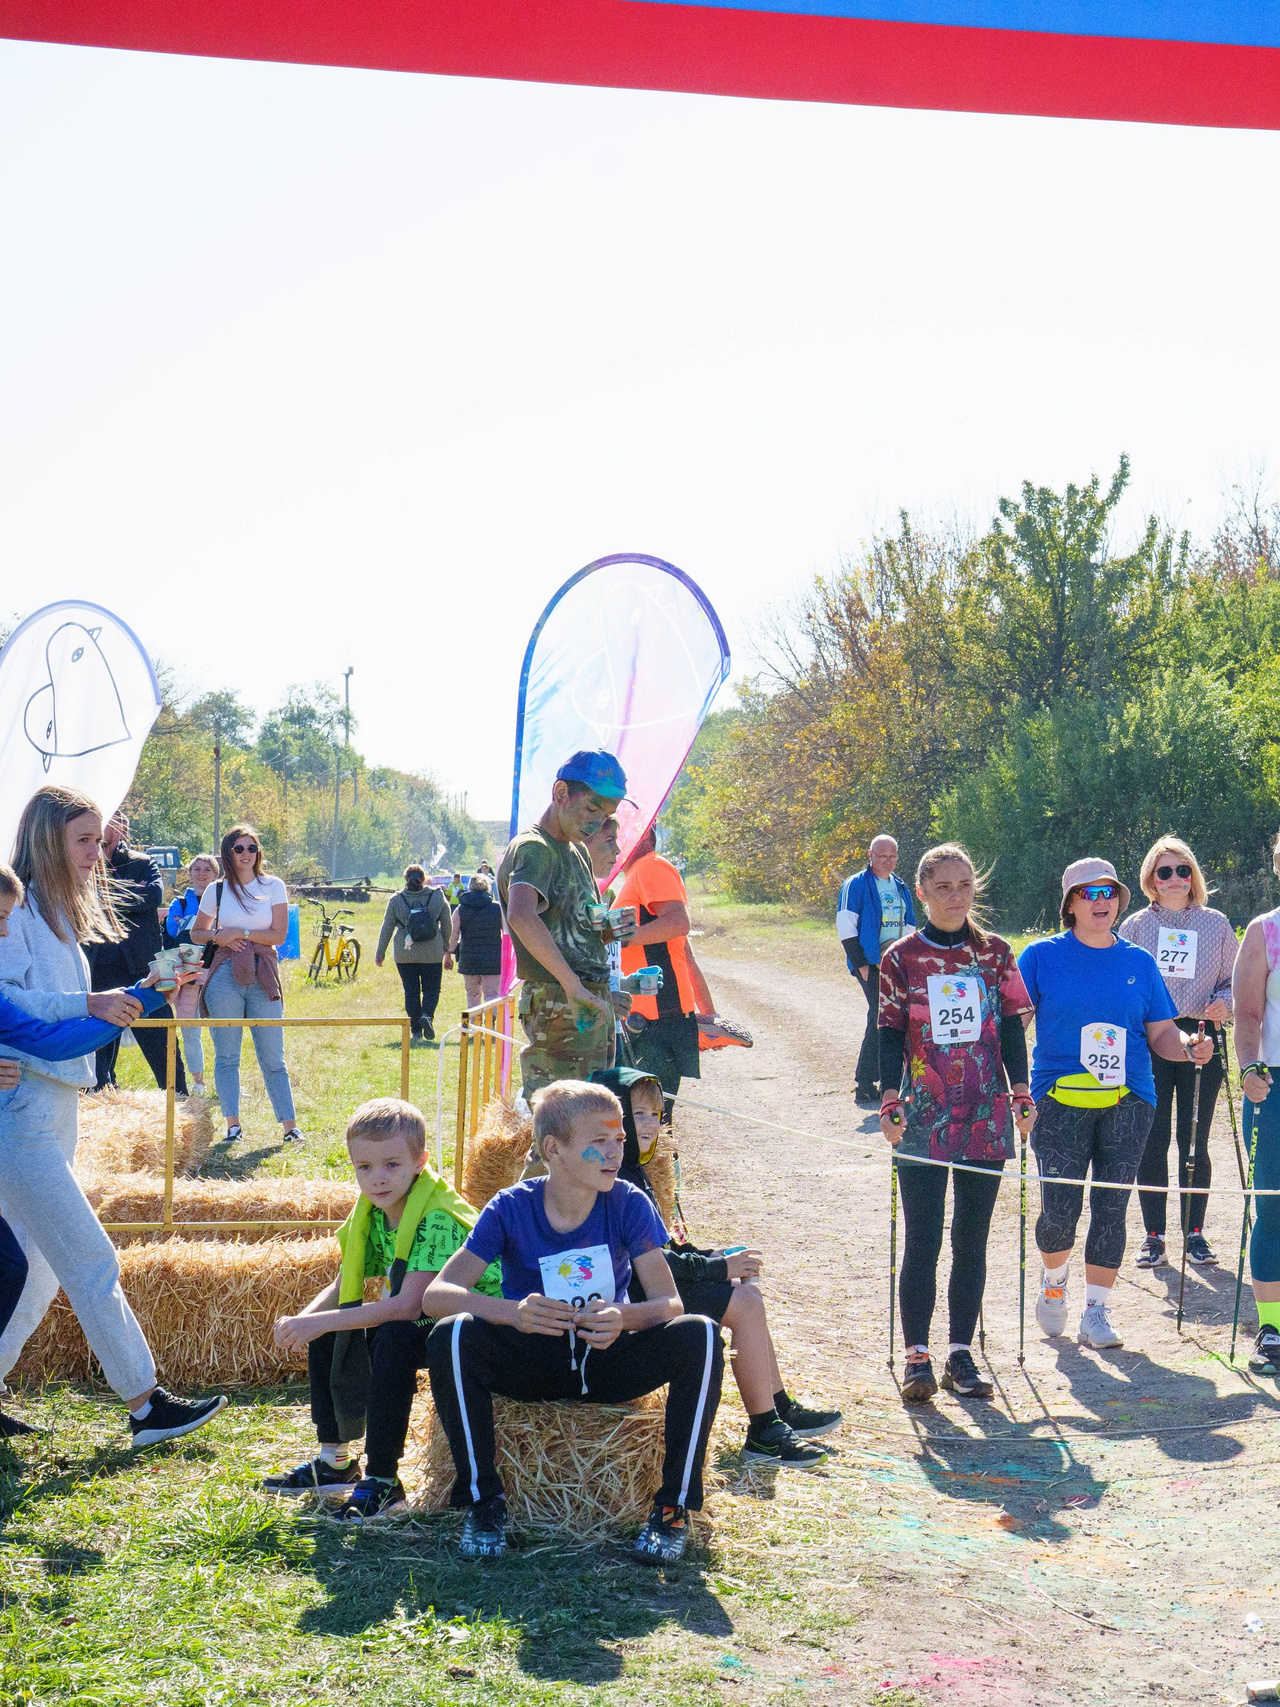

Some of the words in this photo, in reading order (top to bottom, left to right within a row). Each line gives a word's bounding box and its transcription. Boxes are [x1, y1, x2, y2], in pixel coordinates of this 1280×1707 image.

[1160, 949, 1189, 964] 277
[938, 1006, 975, 1026] 254
[1088, 1053, 1121, 1070] 252
